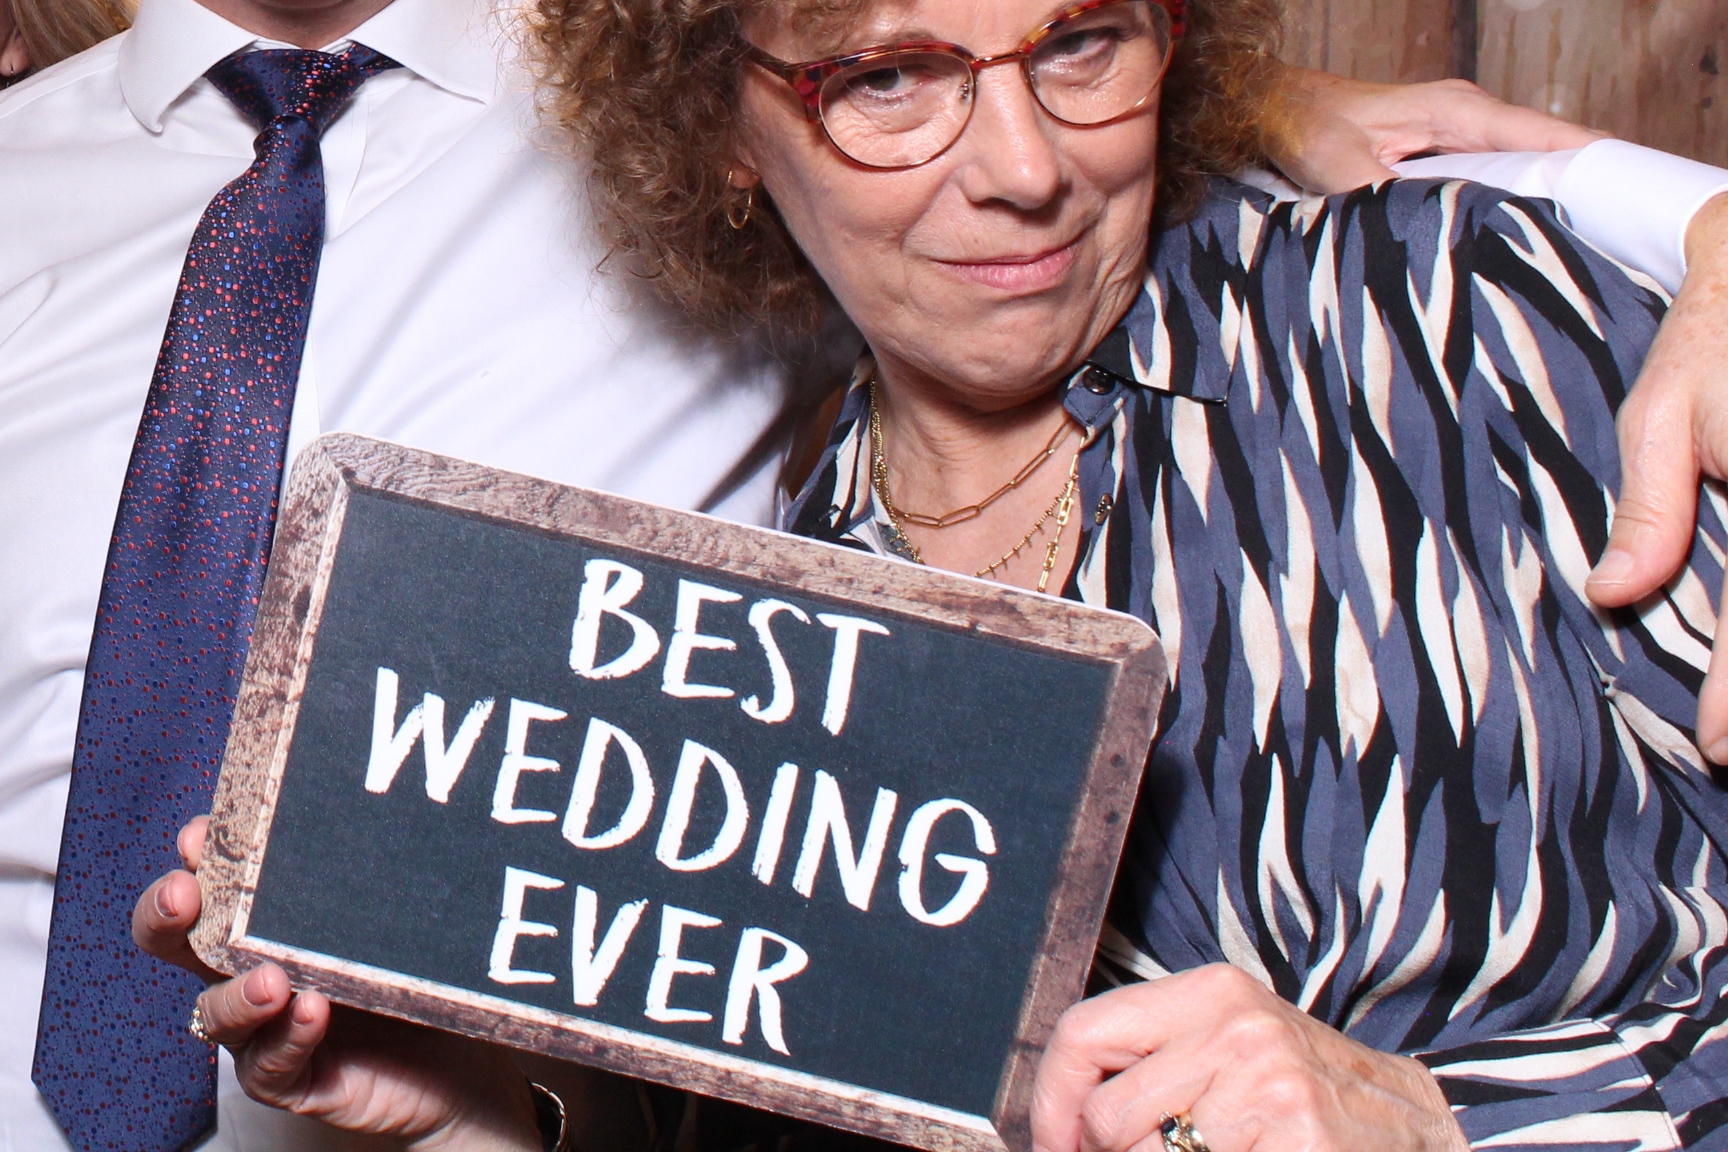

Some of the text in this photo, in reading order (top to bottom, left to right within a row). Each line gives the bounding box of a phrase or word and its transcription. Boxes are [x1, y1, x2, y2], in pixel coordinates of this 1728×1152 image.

[569, 558, 891, 736] BEST
[364, 666, 997, 927] WEDDING
[487, 866, 810, 1056] EVER
